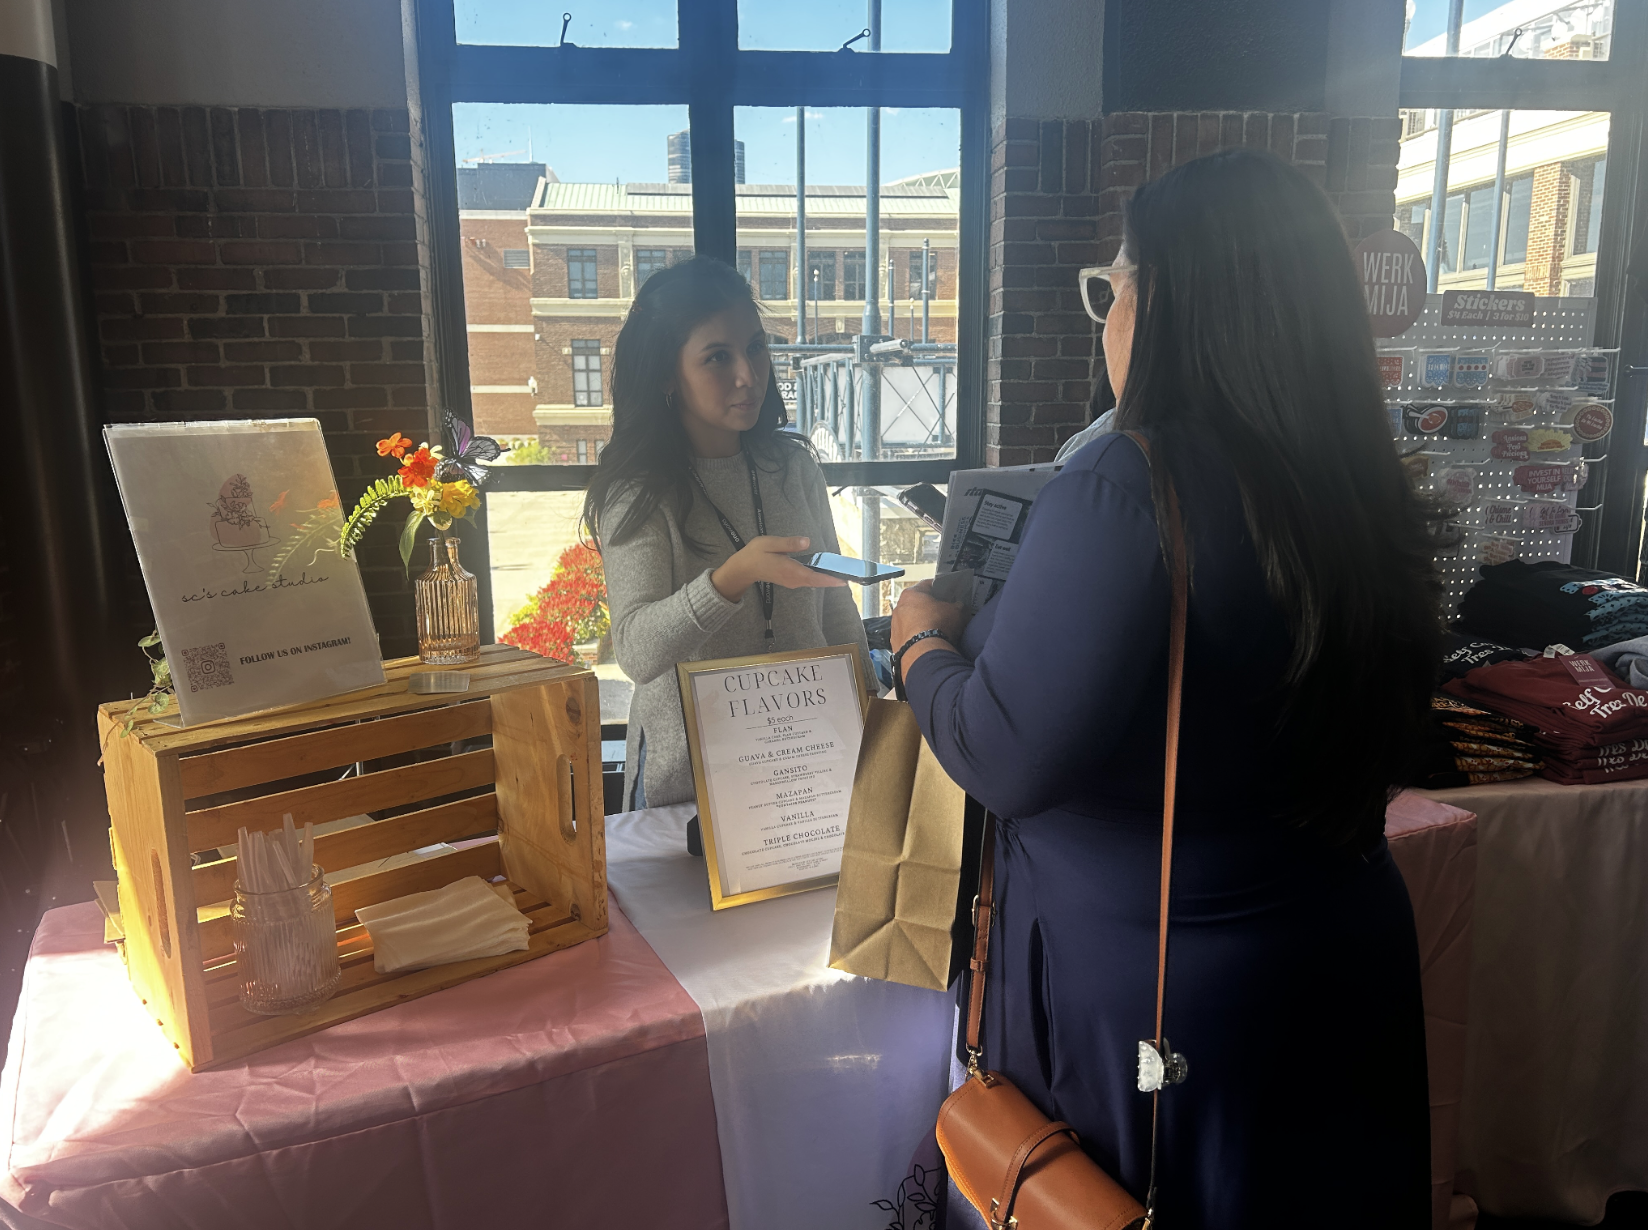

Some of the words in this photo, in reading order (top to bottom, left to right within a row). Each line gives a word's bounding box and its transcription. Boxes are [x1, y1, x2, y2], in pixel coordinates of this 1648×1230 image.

[1363, 252, 1414, 284] WERK
[1364, 285, 1409, 316] MIJA
[1454, 294, 1526, 311] Stickers
[1447, 309, 1460, 320] $4
[1461, 310, 1483, 320] Each
[1493, 311, 1499, 320] 3
[1500, 311, 1513, 321] for
[1515, 312, 1529, 322] $10
[776, 382, 792, 391] OD
[1529, 469, 1552, 477] INVEST
[1527, 476, 1561, 484] YOURSELF
[220, 581, 268, 597] cake
[271, 572, 329, 589] studio
[240, 651, 275, 666] FOLLOW
[277, 648, 289, 659] US
[290, 646, 302, 657] ON
[304, 637, 351, 653] INSTAGRAM!
[1575, 665, 1595, 673] MIJA
[724, 664, 823, 693] CUPCAKE
[729, 688, 827, 718] FLAVORS
[767, 716, 776, 726] $5
[776, 714, 794, 724] each
[773, 725, 793, 734] FLAN
[738, 753, 766, 763] GUAVA
[776, 747, 803, 757] CREAM
[805, 741, 834, 752] CHEESE
[773, 765, 808, 777] GANSITO
[776, 787, 813, 799] MAZAPAN
[780, 811, 815, 822] VANILLA
[763, 834, 791, 846] TRIPLE
[793, 825, 841, 841] CHOCOLATE
